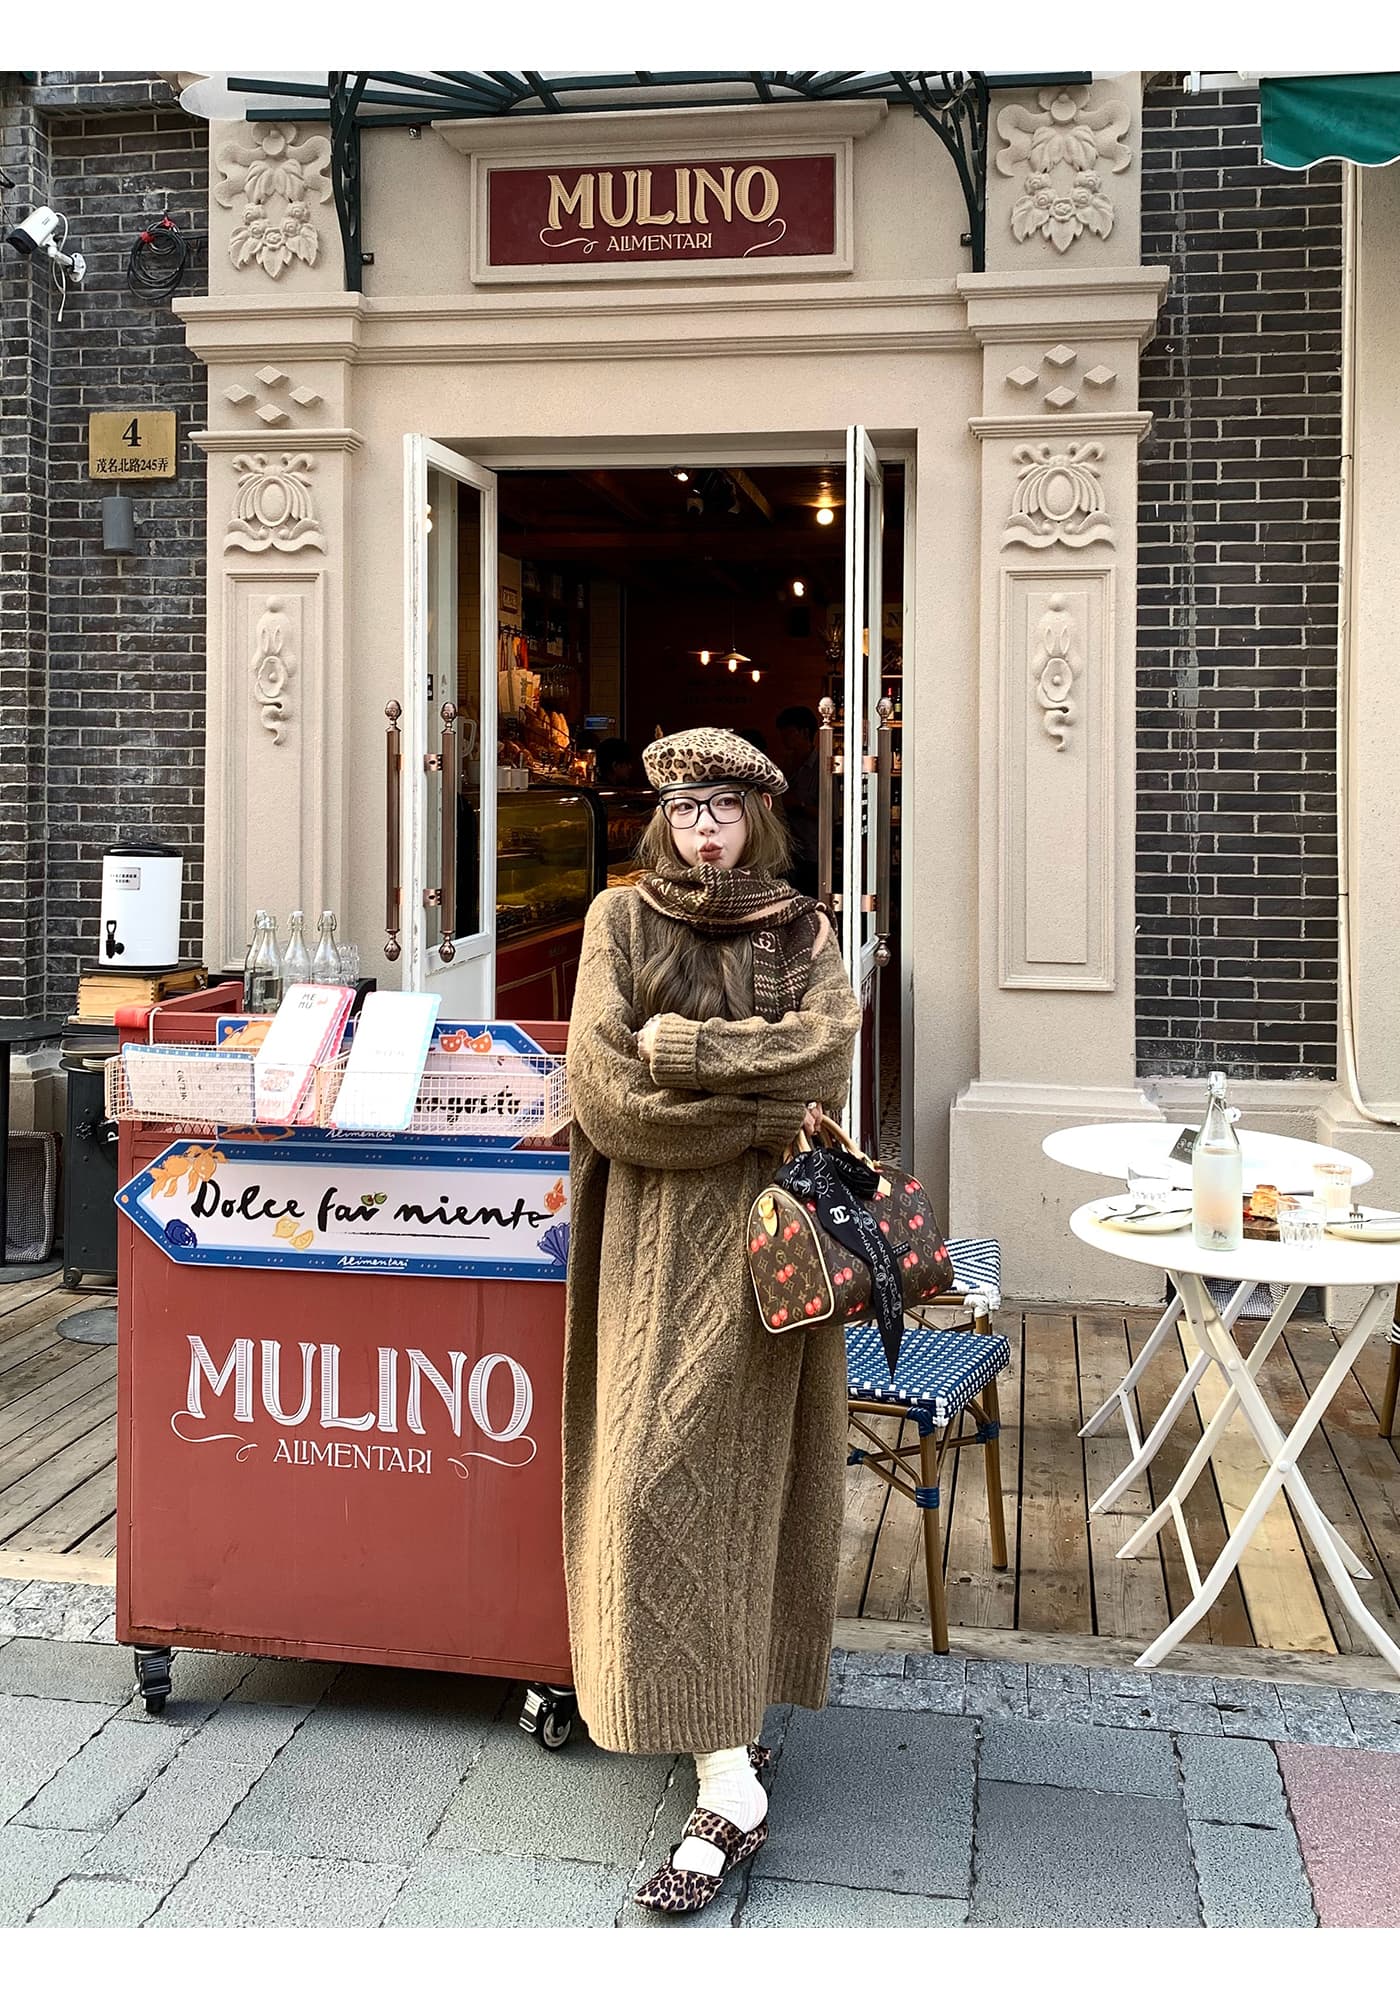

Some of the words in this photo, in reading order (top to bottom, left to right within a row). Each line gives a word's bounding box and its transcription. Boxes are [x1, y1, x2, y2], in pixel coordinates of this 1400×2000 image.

[547, 165, 780, 230] MULINO
[606, 232, 713, 252] ALIMENTARI
[122, 418, 142, 447] 4
[96, 457, 169, 473] 茂名北路245弄
[191, 1179, 305, 1220] Dolce
[393, 1195, 555, 1230] niente
[337, 1256, 409, 1267] Alimentari
[186, 1335, 534, 1443] MULINO
[272, 1438, 433, 1475] ALIMENTARI
